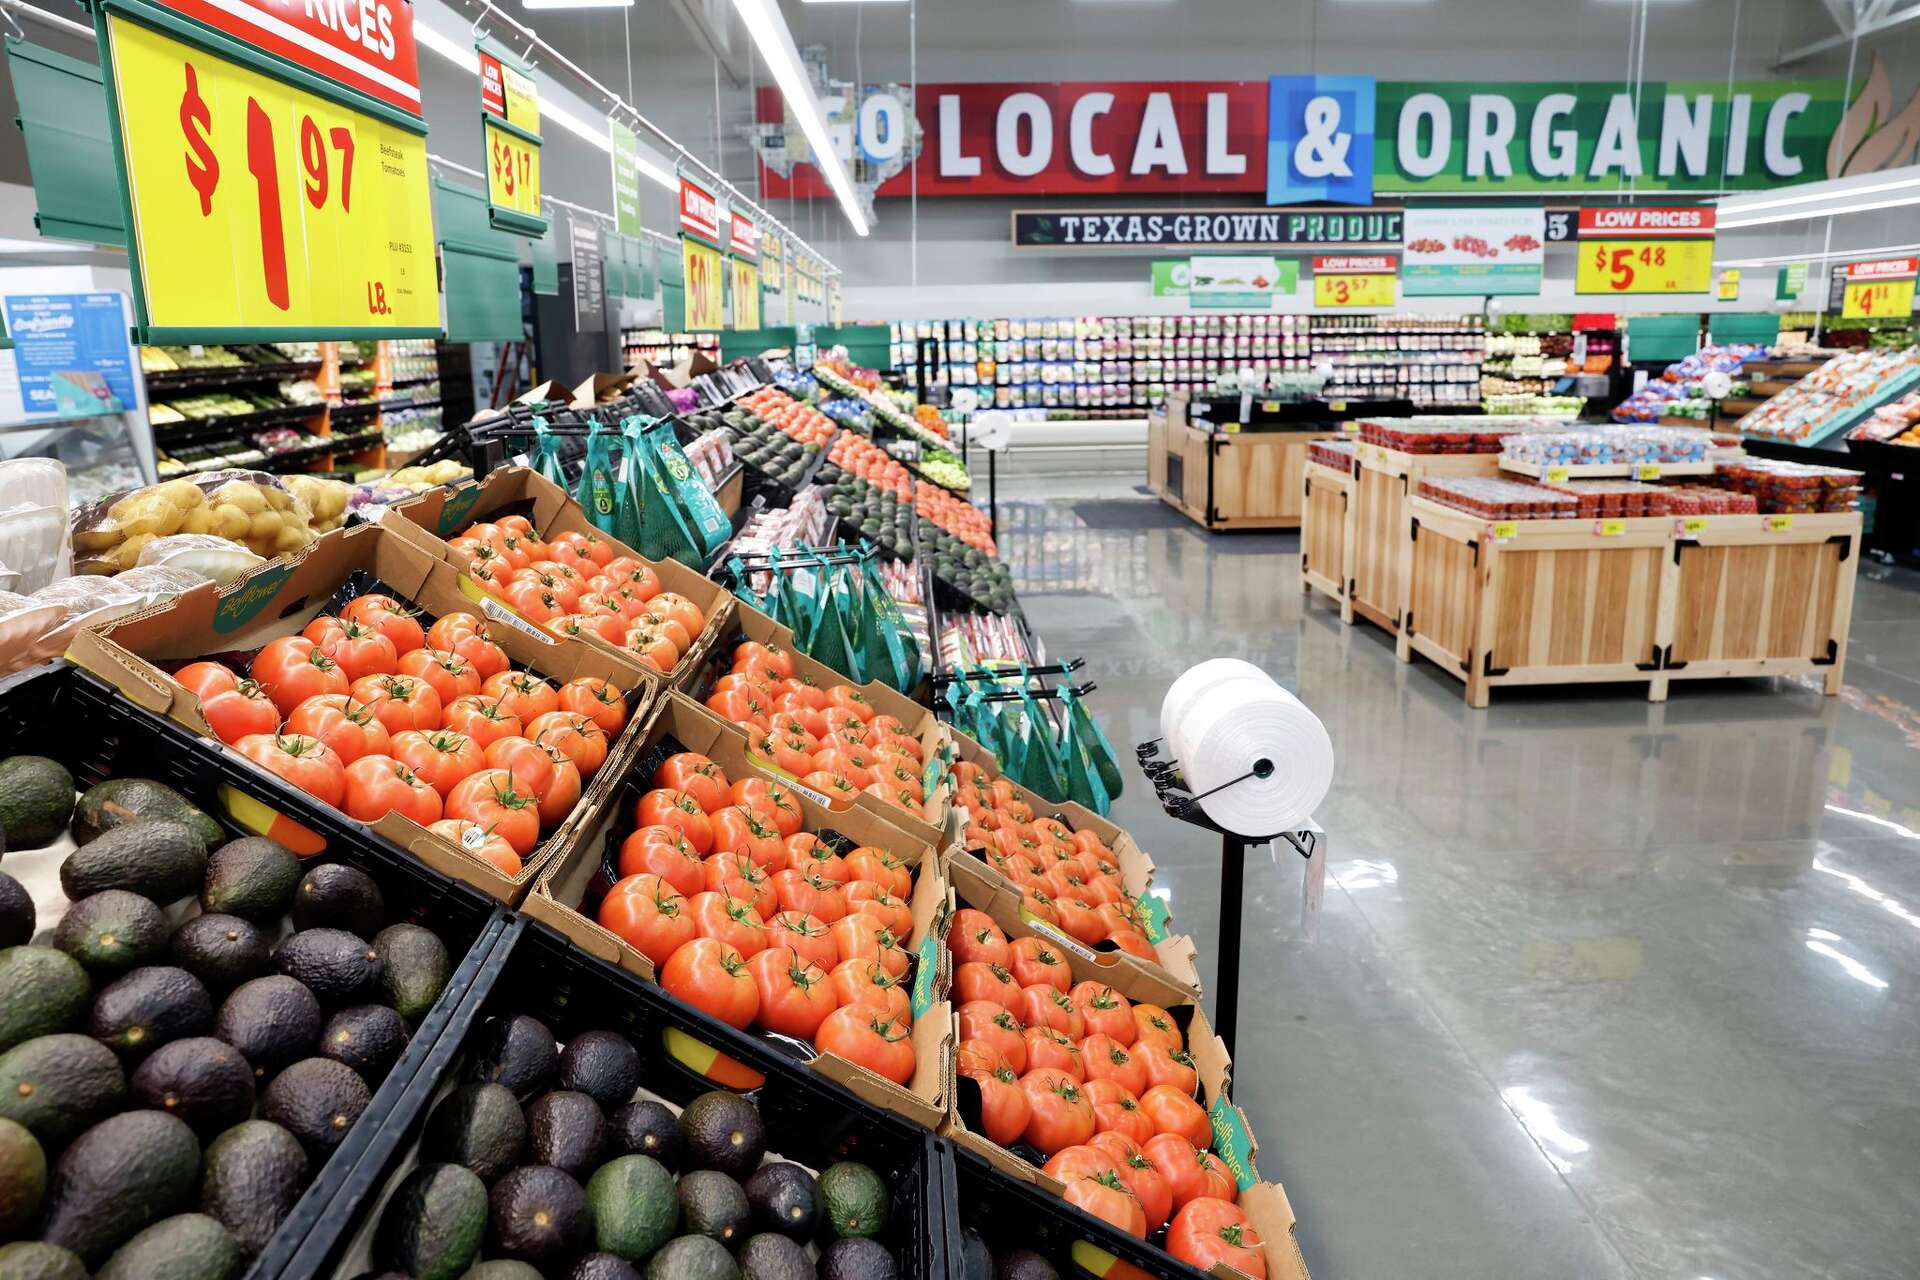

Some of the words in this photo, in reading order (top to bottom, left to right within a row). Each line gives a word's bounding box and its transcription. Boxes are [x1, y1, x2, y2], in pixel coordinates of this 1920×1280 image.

[286, 0, 395, 61] ICES
[485, 63, 498, 80] LOW
[483, 76, 502, 96] PRICES
[938, 92, 1247, 177] LOCAL
[1293, 96, 1354, 178] &
[1398, 92, 1813, 178] ORGANIC
[1060, 214, 1280, 242] TEXAS-GROWN
[1595, 212, 1636, 227] LOW
[1640, 211, 1702, 227] PRICES
[1322, 257, 1349, 268] LOW
[1350, 257, 1388, 268] PRICES
[367, 281, 392, 315] LB.
